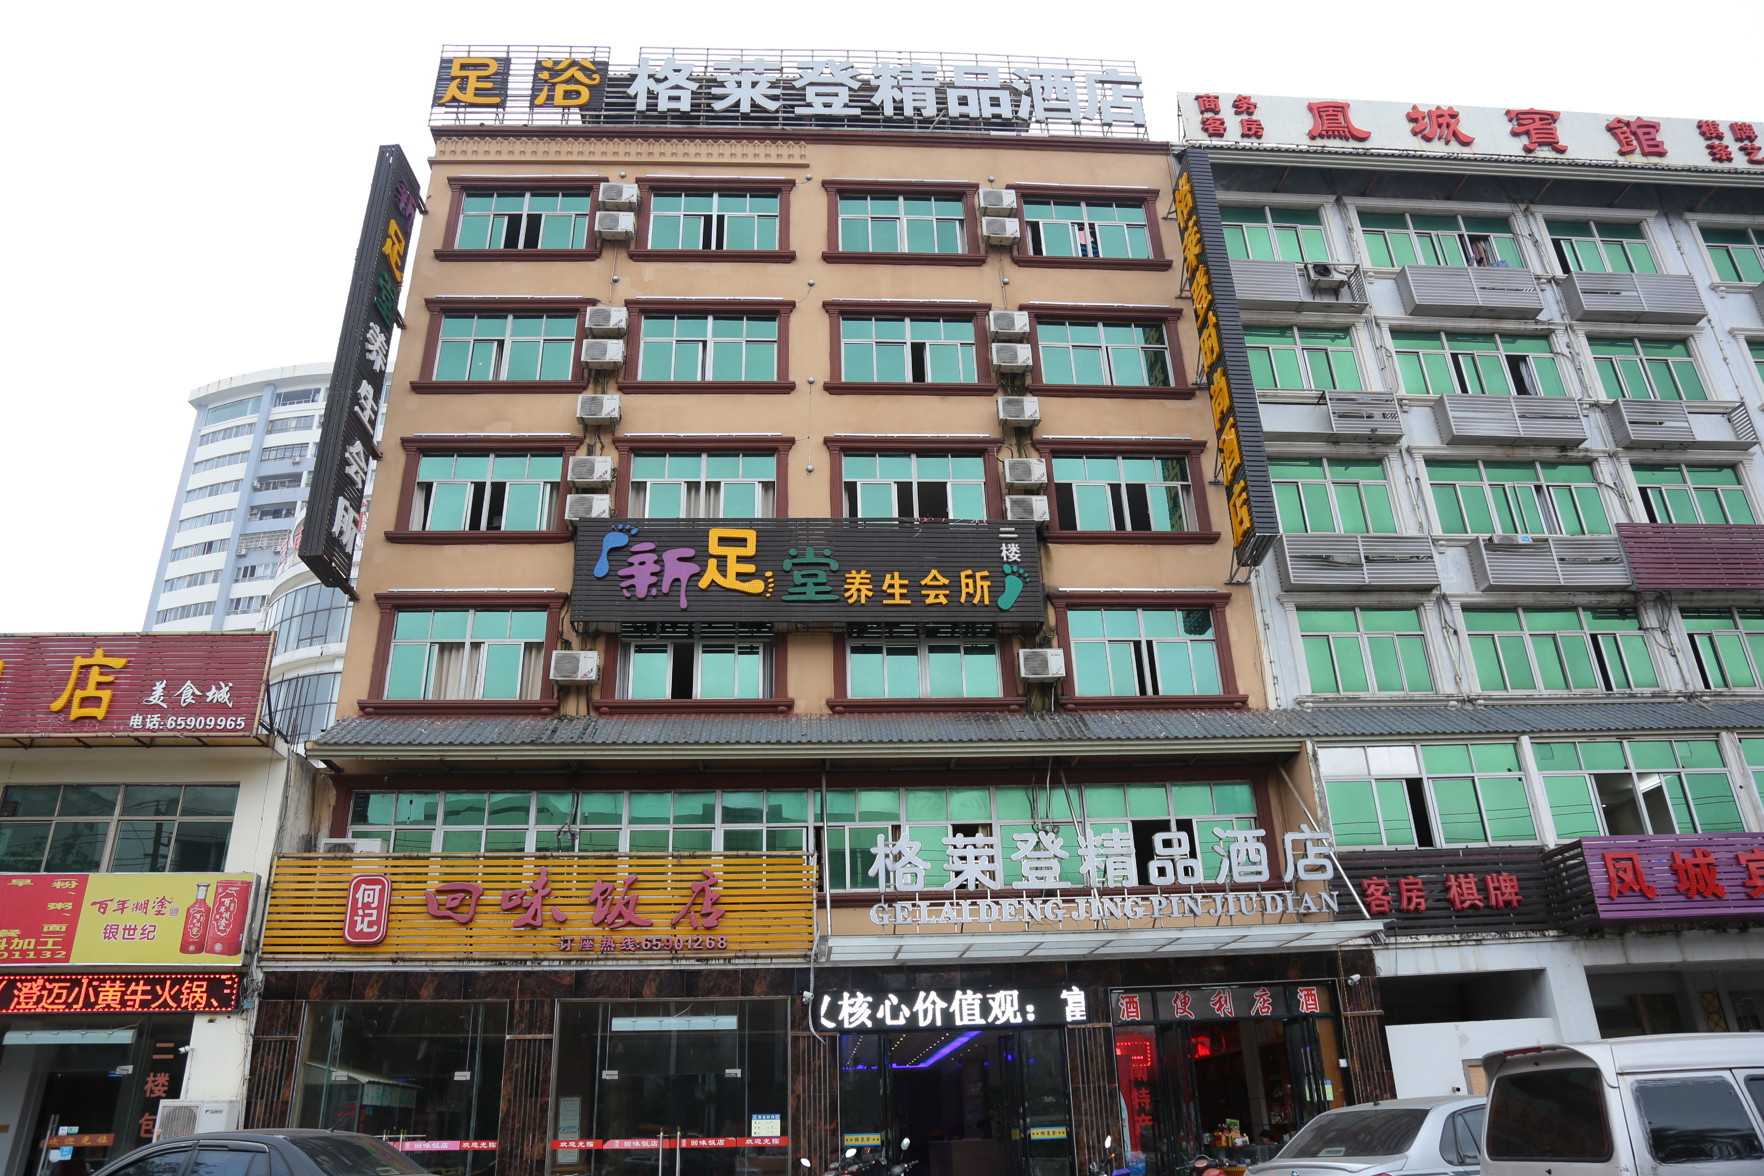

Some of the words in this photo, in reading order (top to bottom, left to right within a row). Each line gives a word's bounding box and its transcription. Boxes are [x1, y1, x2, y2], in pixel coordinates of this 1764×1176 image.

[438, 57, 601, 107] 足浴
[627, 57, 1145, 127] 格莱登精品酒店
[1195, 93, 1258, 116] 商务
[1200, 116, 1264, 139] 客房
[1696, 120, 1758, 143] 棋牌
[998, 527, 1021, 563] 二楼
[844, 569, 991, 606] 养生会所
[50, 649, 128, 720] 店
[143, 680, 233, 708] 美食城
[868, 824, 1335, 892] 格莱登精品酒店
[354, 883, 382, 932] 何记
[424, 866, 726, 929] 回味饭店
[1361, 877, 1427, 915] 客房
[1445, 872, 1524, 912] 棋牌
[102, 923, 157, 941] 银世纪
[1119, 994, 1141, 1021] 酒
[1172, 987, 1273, 1019] 便利店
[1298, 986, 1320, 1013] 酒
